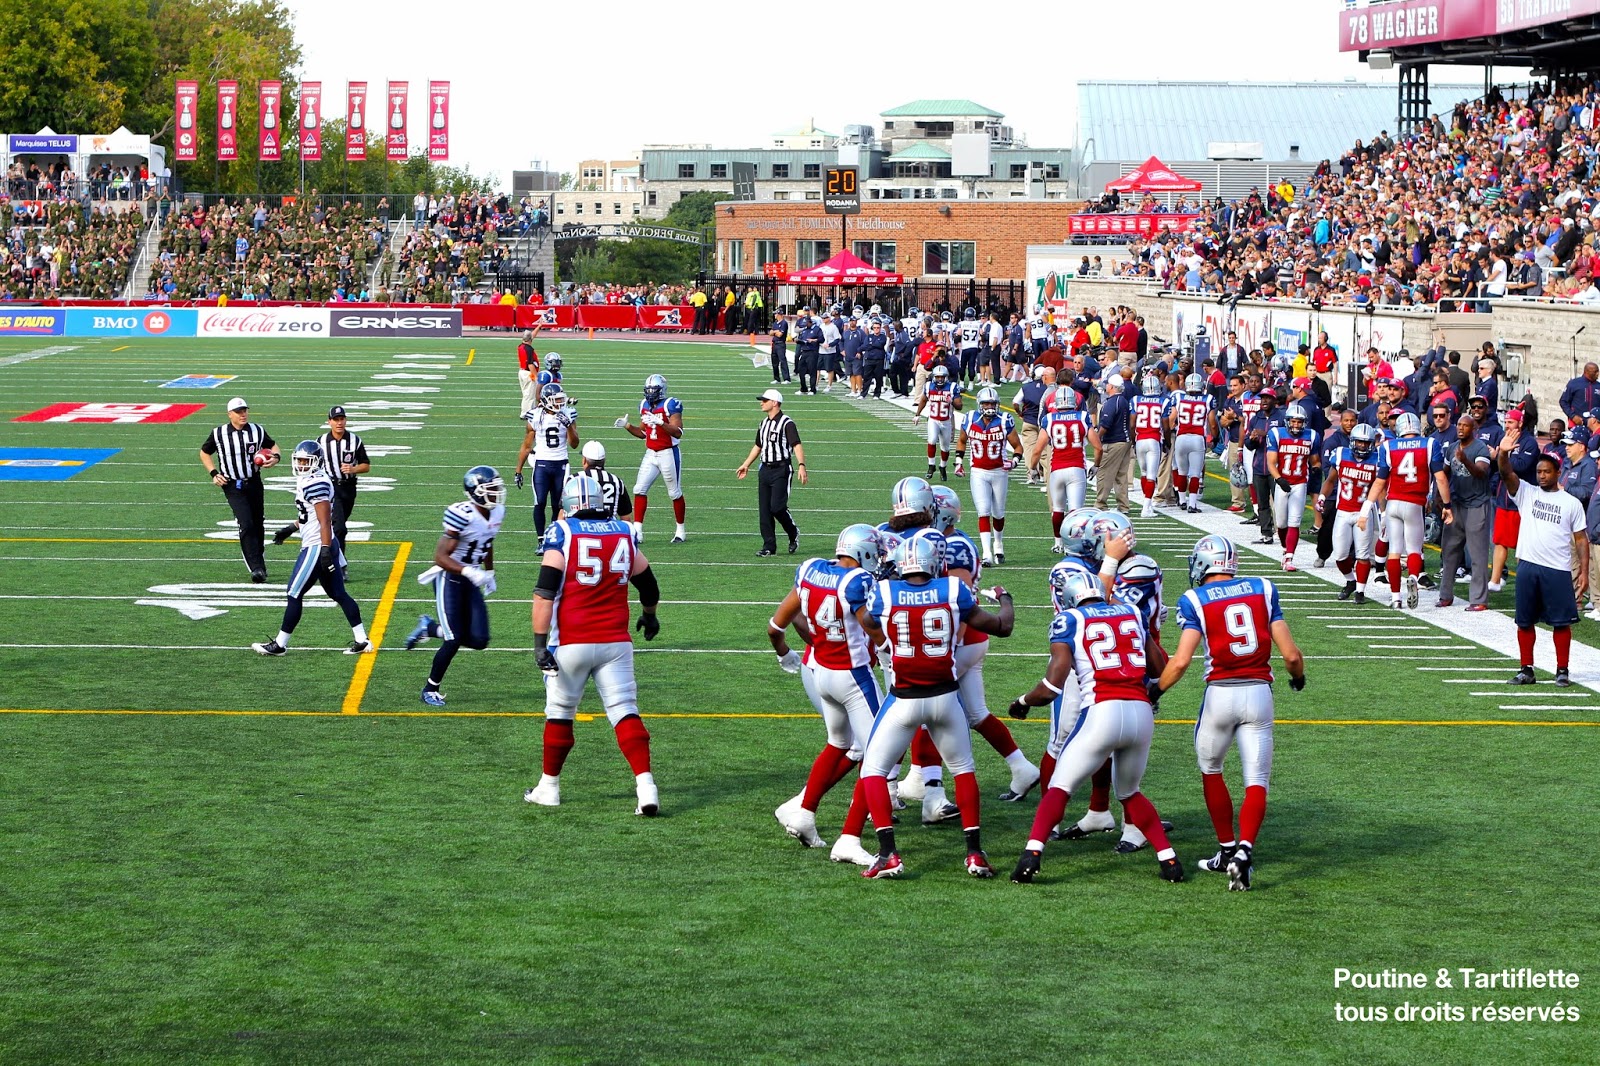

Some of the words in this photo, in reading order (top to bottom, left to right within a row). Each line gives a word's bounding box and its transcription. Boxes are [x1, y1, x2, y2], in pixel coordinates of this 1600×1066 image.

[1349, 15, 1368, 44] 78
[1373, 6, 1438, 41] WAGNER
[15, 139, 47, 148] Marquises
[49, 139, 71, 147] TELUS
[828, 171, 854, 192] 20
[857, 217, 905, 229] Fieldhouse
[93, 317, 137, 329] BMO
[278, 321, 323, 332] zero
[963, 329, 978, 342] 57
[929, 402, 949, 417] 35
[1055, 413, 1078, 421] LAVOIE
[1136, 405, 1161, 429] 26
[1180, 403, 1206, 426] 52
[545, 427, 559, 448] 6
[969, 430, 1004, 441] ALOUETTES
[1052, 423, 1082, 449] 81
[1397, 440, 1421, 449] MARSH
[971, 439, 1001, 460] 00
[1279, 445, 1311, 456] ALOUETTES
[1282, 454, 1303, 476] 11
[1342, 467, 1372, 480] ALOUETTES
[1398, 452, 1418, 483] 4
[1340, 477, 1370, 503] 37
[1533, 499, 1562, 514] MONTRÉAL
[575, 537, 631, 586] 54
[804, 567, 839, 588] LONDON
[898, 588, 939, 605] GREEN
[1206, 581, 1253, 600] DESLAURIERS
[800, 587, 846, 642] 14
[892, 607, 951, 658] 19
[1223, 602, 1259, 657] 9
[1085, 619, 1147, 670] 23
